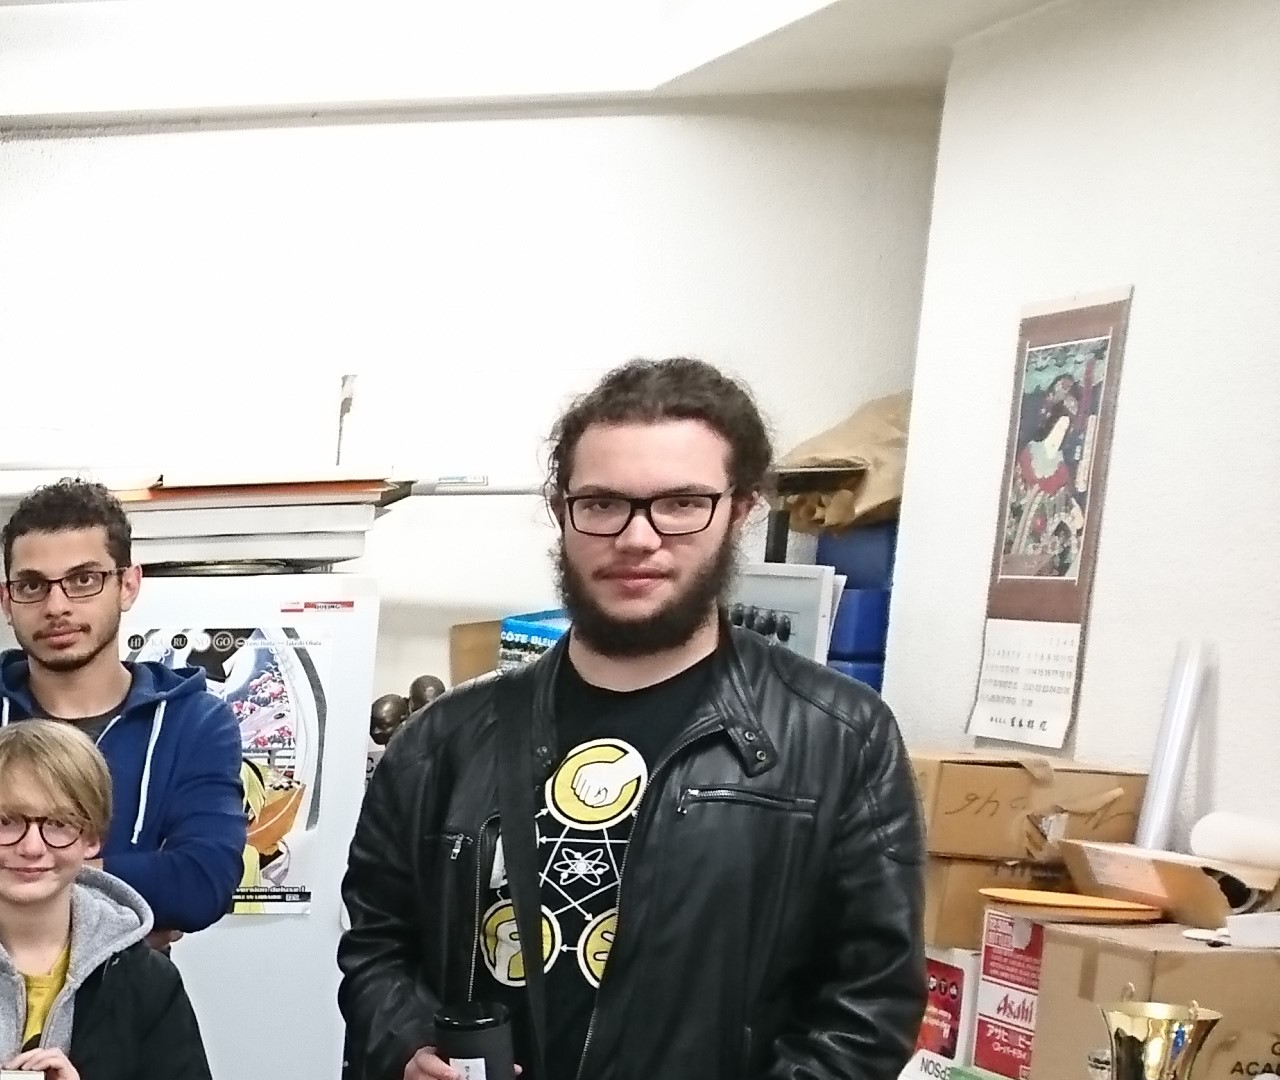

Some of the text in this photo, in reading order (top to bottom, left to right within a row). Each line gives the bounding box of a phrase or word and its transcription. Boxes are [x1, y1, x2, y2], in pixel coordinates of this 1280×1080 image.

[130, 637, 141, 647] HI
[173, 637, 187, 647] RU
[215, 637, 231, 647] GO
[501, 631, 529, 643] CÔTE
[996, 993, 1034, 1024] Asahi
